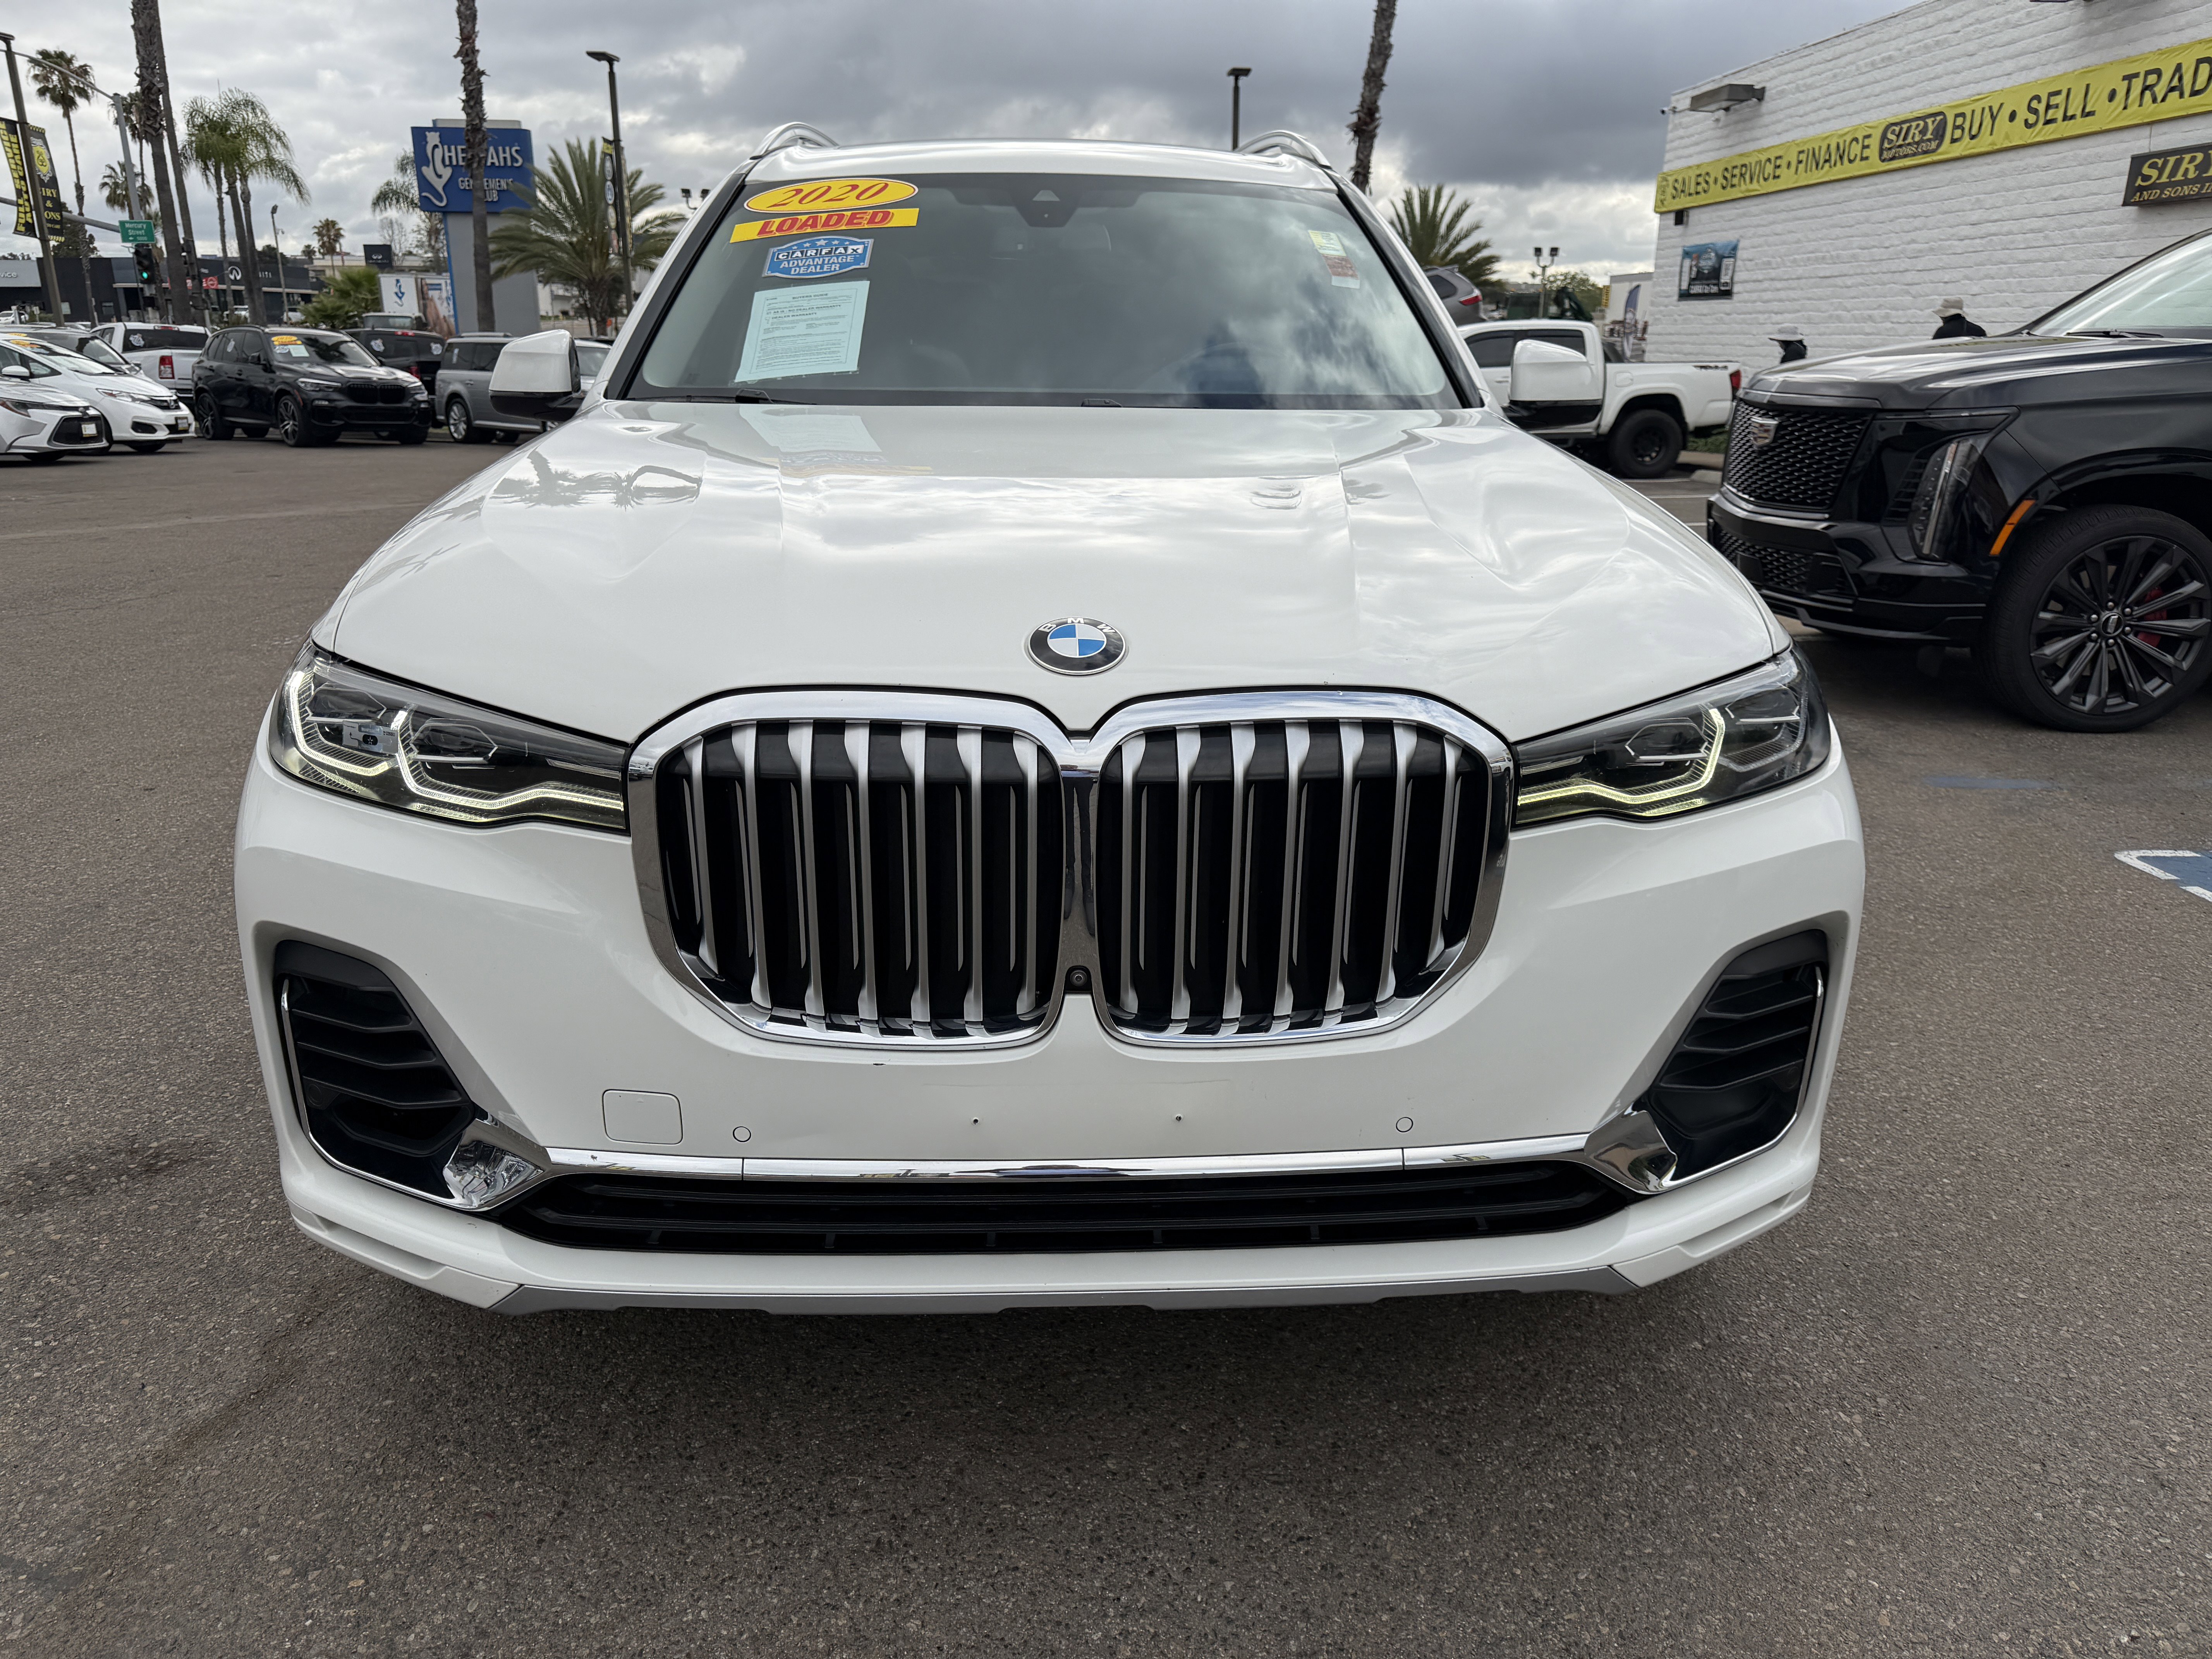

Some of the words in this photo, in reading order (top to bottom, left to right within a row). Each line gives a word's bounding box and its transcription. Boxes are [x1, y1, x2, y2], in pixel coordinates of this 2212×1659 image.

[1670, 171, 1711, 200] SALES
[1720, 155, 1783, 191] SERVICE
[1794, 133, 1873, 175] FINANCE
[1882, 115, 1944, 149] SIRY
[1950, 102, 2005, 144] BUY
[2024, 83, 2096, 129] SELL
[1881, 140, 1940, 160] MOTORS.COM
[9, 134, 24, 177] CARE
[20, 180, 33, 224] AUTO
[41, 187, 57, 198] IRY
[766, 182, 889, 208] 2020
[2131, 189, 2160, 202] AND
[2162, 184, 2202, 198] SONS
[17, 198, 26, 232] FULL
[44, 211, 61, 221] ONS
[757, 210, 893, 237] LOADED
[776, 246, 862, 260] CARFAX
[780, 255, 855, 268] ADVANTAGE
[790, 264, 840, 275] DEALER
[1038, 617, 1116, 632] BMW
